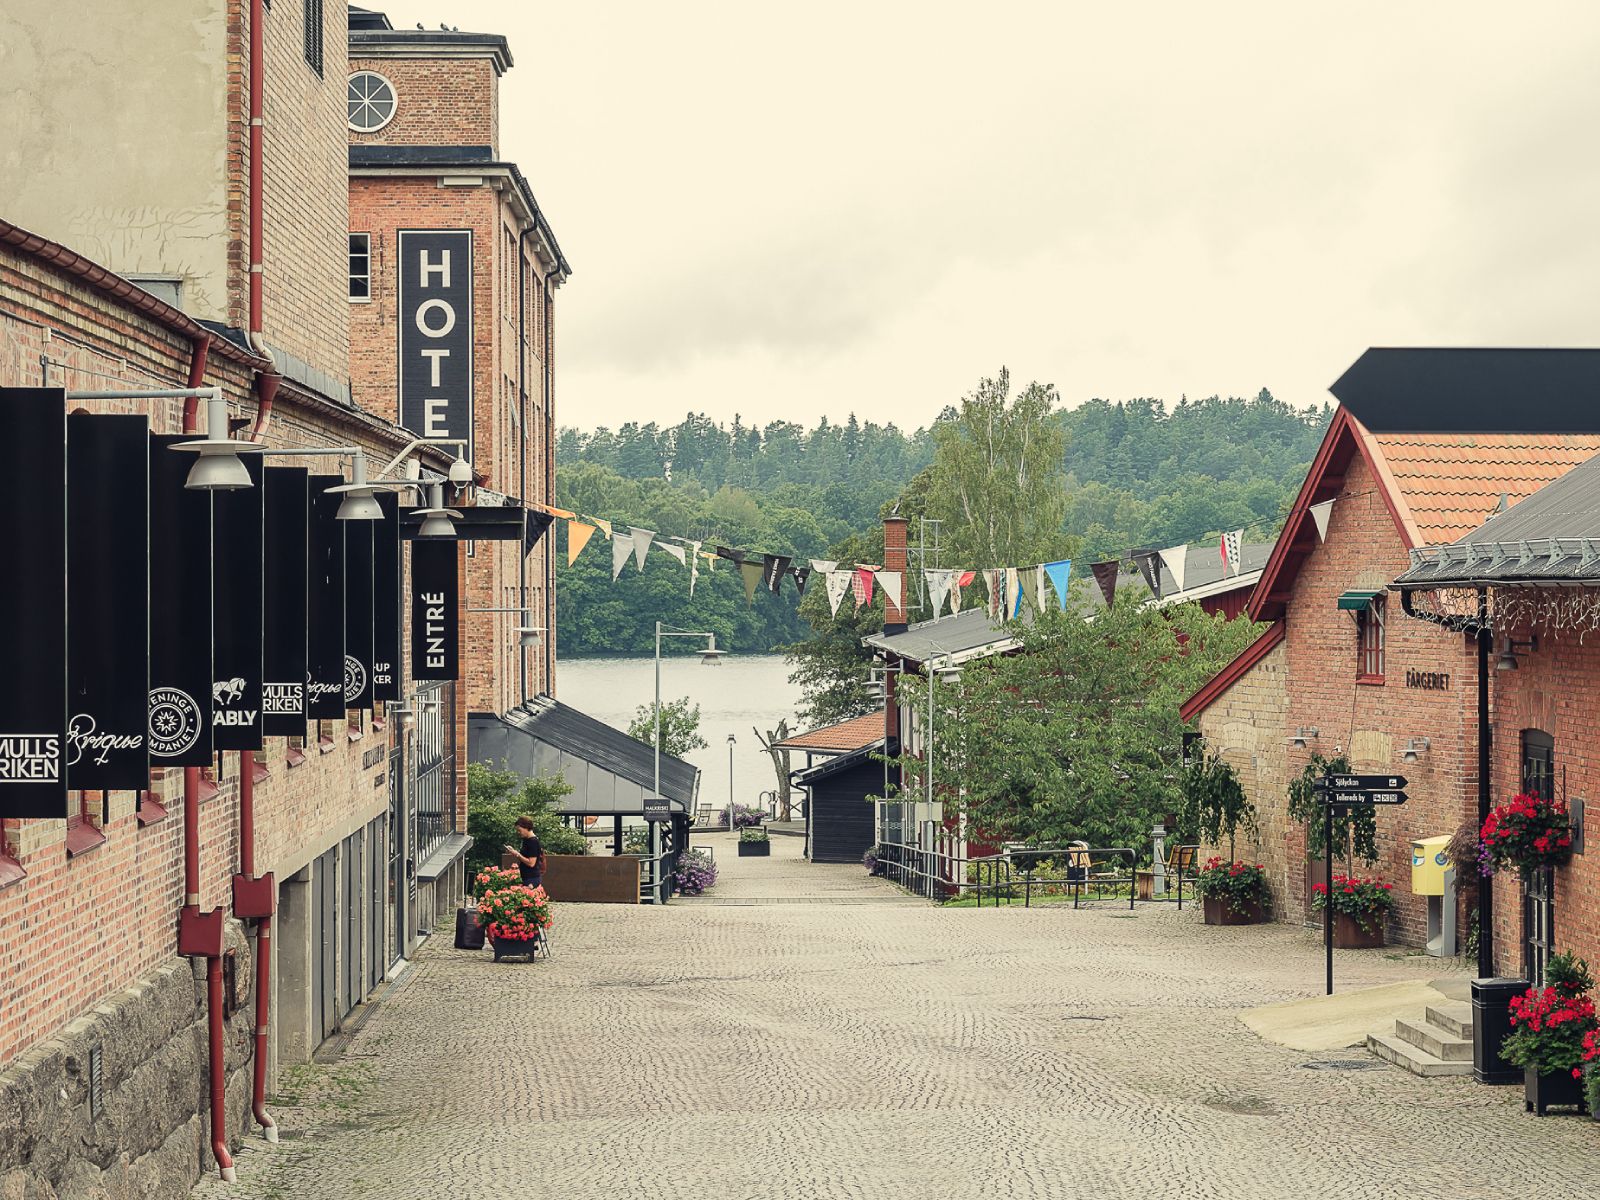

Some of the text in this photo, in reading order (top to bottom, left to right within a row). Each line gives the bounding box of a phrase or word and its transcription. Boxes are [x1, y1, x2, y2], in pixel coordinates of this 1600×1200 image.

[420, 592, 445, 668] ENTRÉ
[148, 693, 193, 714] ENINGE
[262, 698, 303, 711] RIKEN
[212, 710, 258, 726] ABLY
[66, 713, 143, 766] Brique
[148, 725, 195, 752] MPANIET
[0, 758, 59, 778] RIKEN
[1358, 793, 1366, 803] by
